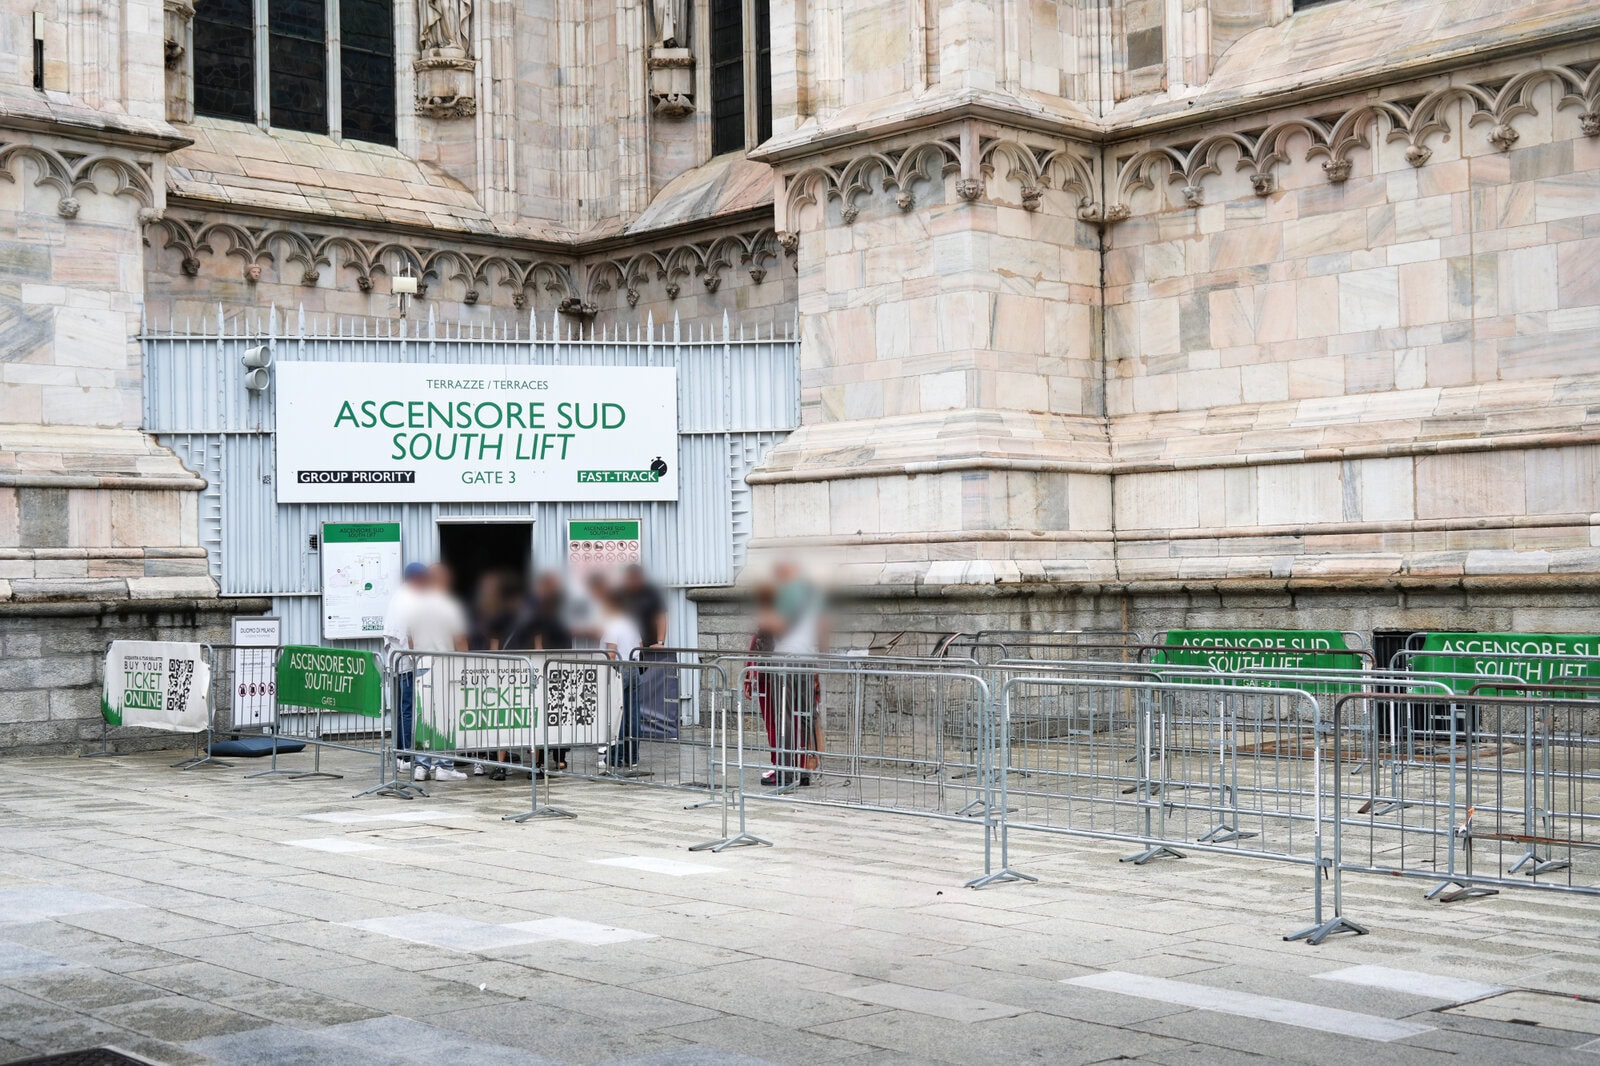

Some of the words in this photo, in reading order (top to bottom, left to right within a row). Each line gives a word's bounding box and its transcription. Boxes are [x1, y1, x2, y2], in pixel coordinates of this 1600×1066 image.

[426, 379, 485, 389] TERRAZZE
[493, 380, 549, 390] TERRACES
[333, 400, 546, 429] ASCENSORE
[556, 402, 626, 430] SUD
[391, 432, 504, 461] SOUTH
[515, 433, 576, 461] LIFT
[300, 471, 349, 483] GROUP
[352, 471, 413, 483] PRIORITY
[461, 471, 503, 484] GATE
[508, 470, 516, 484] 3
[579, 470, 657, 483] FAST-TRACK
[1180, 638, 1286, 655] ASCENSORE
[1291, 638, 1331, 656] SUD
[1441, 640, 1567, 657] ASCENSORE
[124, 660, 139, 670] BUY
[142, 661, 162, 671] YOUR
[290, 653, 345, 673] ASCENSORE
[346, 656, 366, 676] SUD
[1208, 656, 1265, 674] SOUTH
[1475, 661, 1542, 681] SOUTH
[124, 671, 163, 689] TICKET
[304, 672, 333, 691] SOUTH
[334, 675, 354, 694] LIFT
[461, 675, 489, 686] BUY
[125, 691, 162, 708] ONLINE
[460, 686, 538, 707] TICKET
